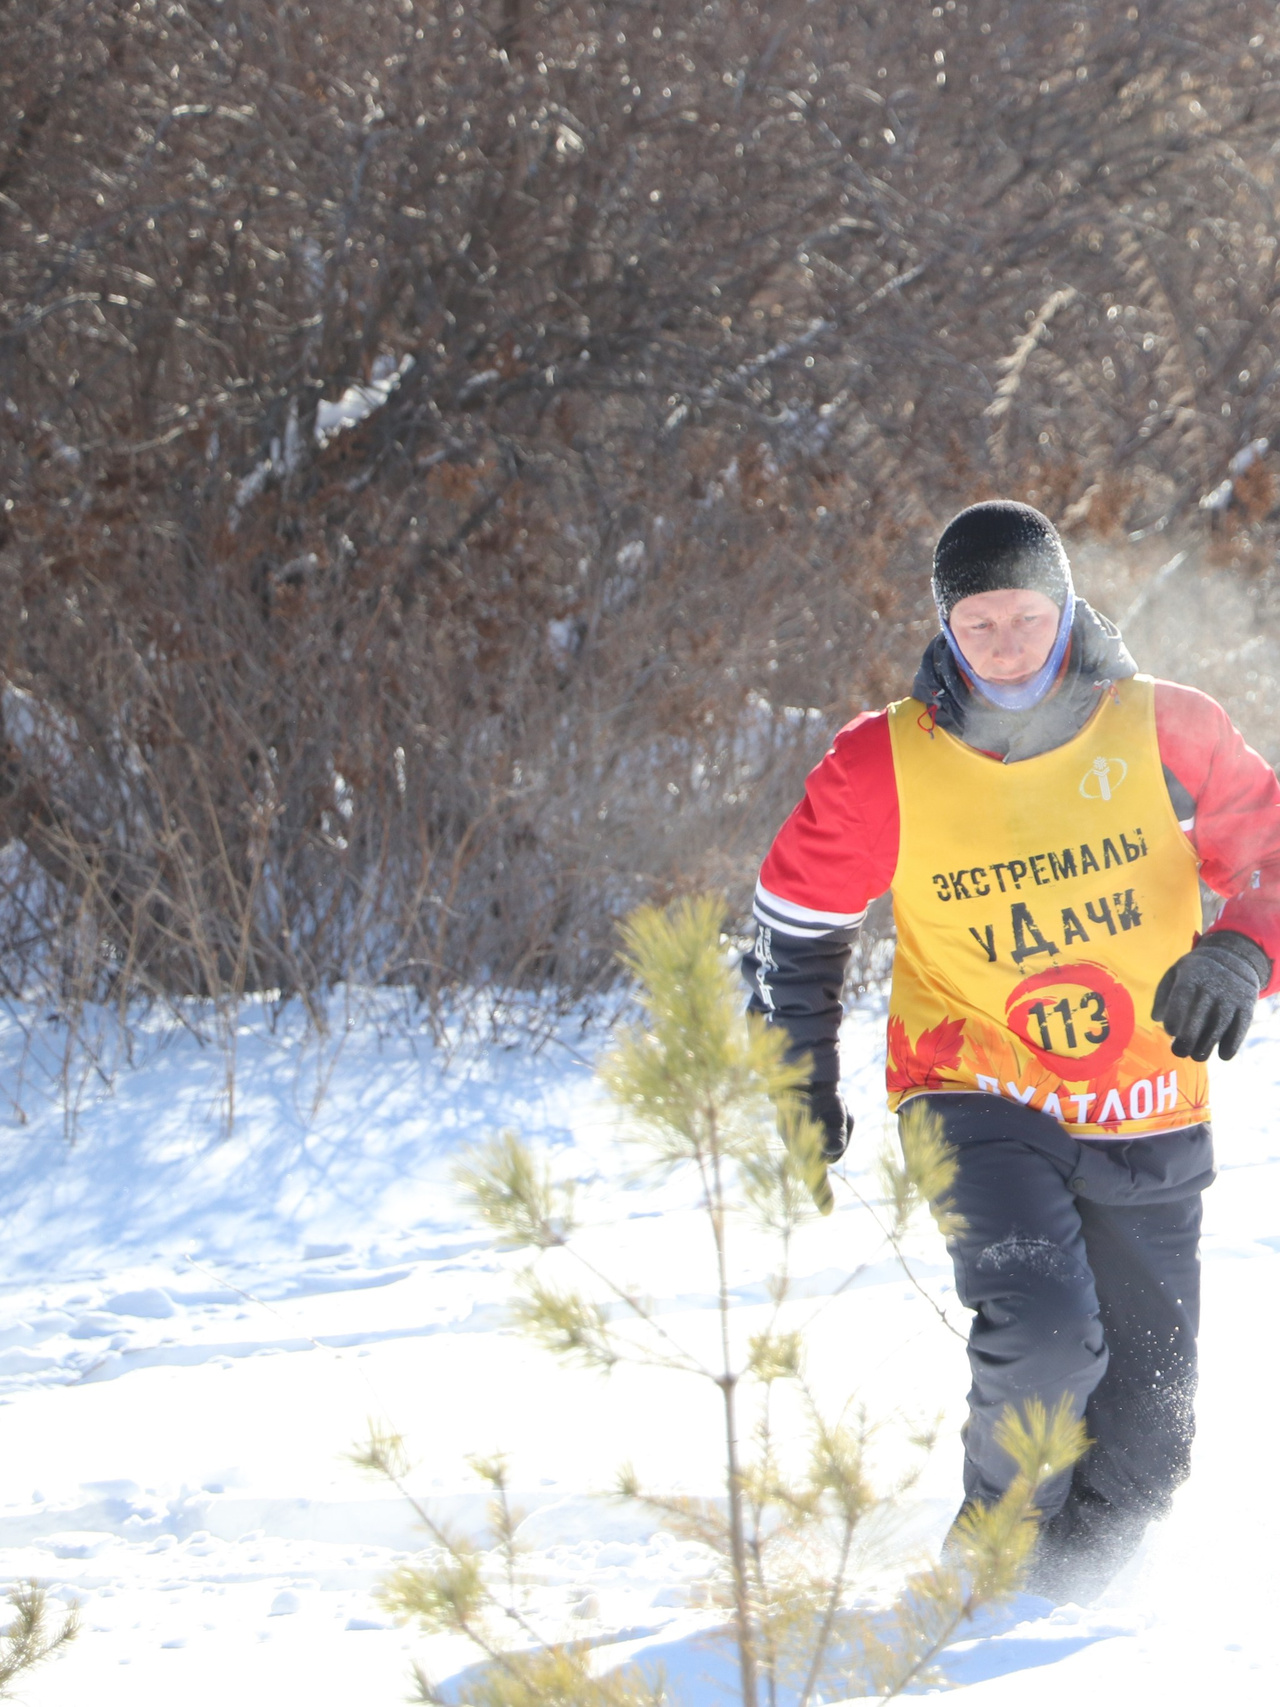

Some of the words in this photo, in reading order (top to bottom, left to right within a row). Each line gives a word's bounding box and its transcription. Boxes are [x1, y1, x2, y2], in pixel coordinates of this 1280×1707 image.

[931, 827, 1148, 902] ЭКСТРЕМАЛЫ
[968, 888, 1144, 966] УДАЧИ
[1028, 991, 1111, 1051] 113
